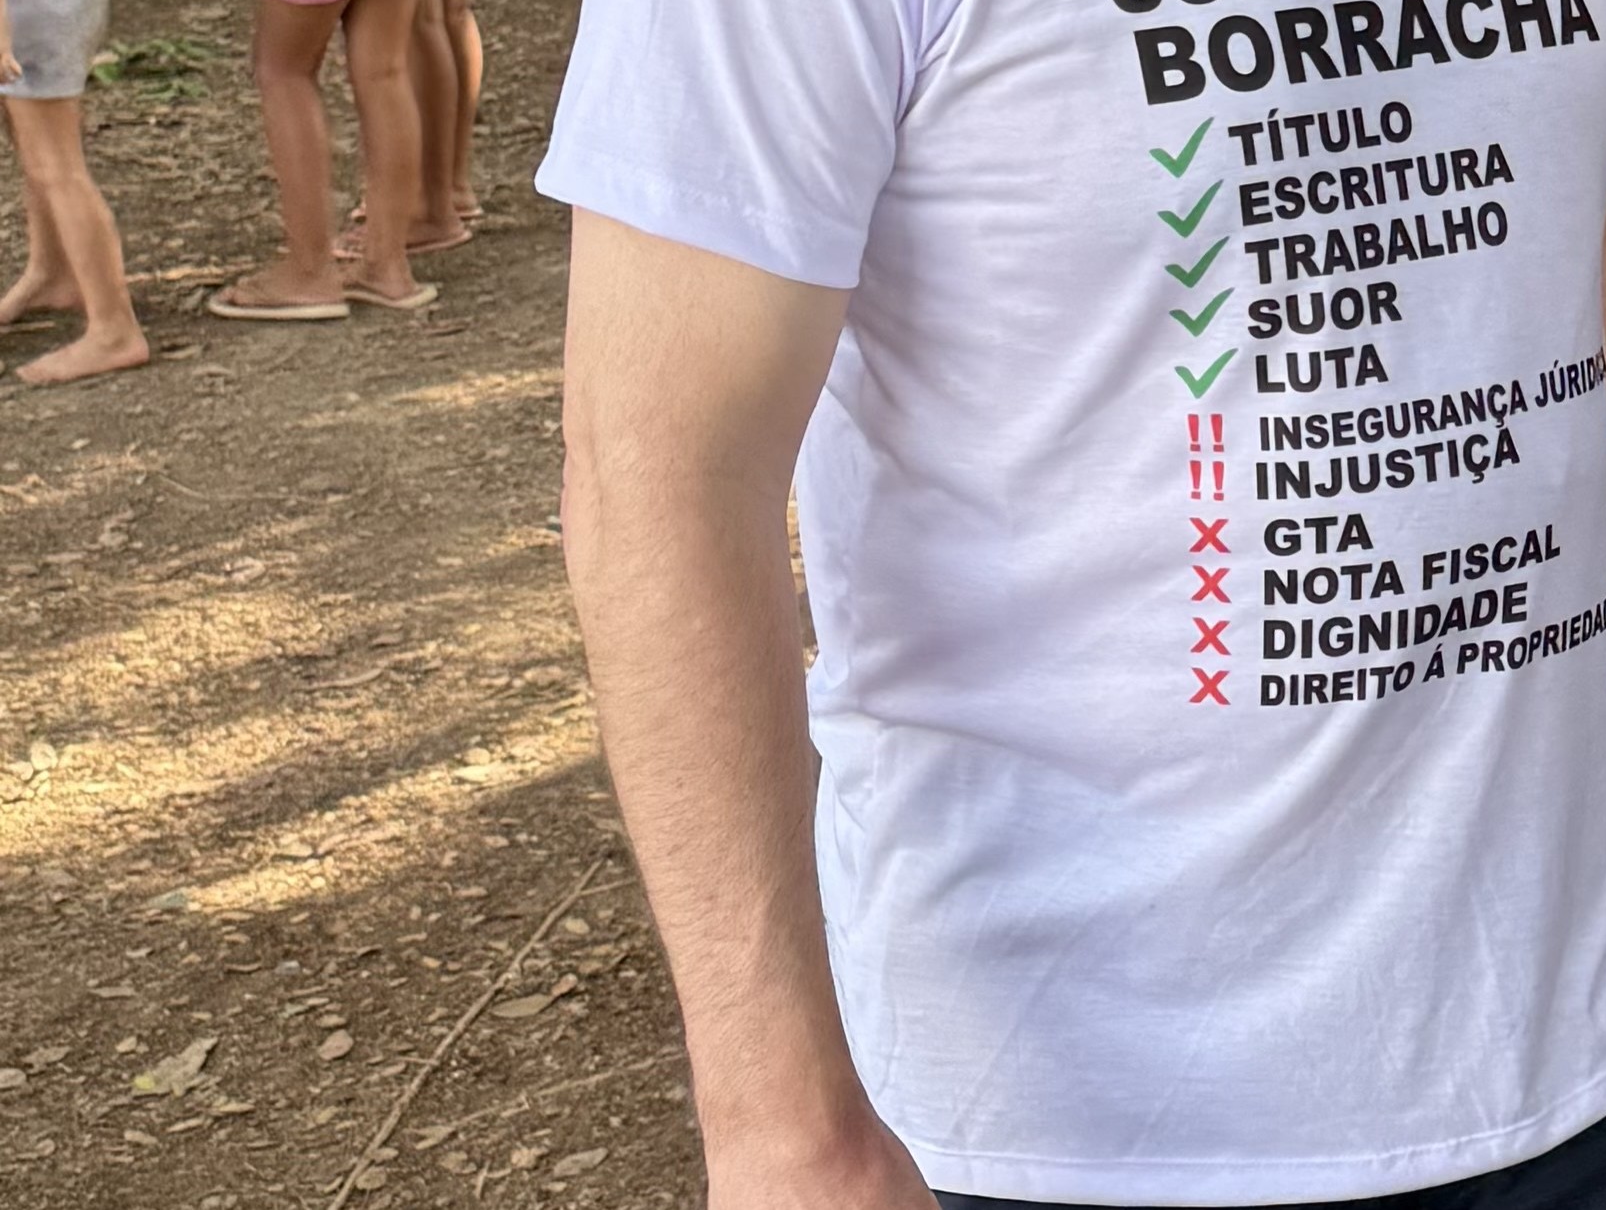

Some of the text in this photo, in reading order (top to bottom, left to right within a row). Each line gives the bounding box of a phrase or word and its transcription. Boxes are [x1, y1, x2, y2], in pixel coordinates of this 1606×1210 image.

[1227, 101, 1413, 167] TÍTULO
[1238, 143, 1515, 227] ESCRITURA
[1244, 201, 1508, 285] TRABALHO
[1247, 281, 1403, 340] SUOR
[1255, 343, 1389, 393] LUTA
[1260, 379, 1529, 451] INSEGURANÇA
[1255, 427, 1521, 500] INJUSTIÇA
[1263, 513, 1374, 557] GTA
[1264, 560, 1405, 606] NOTA
[1422, 523, 1561, 591] FISCAL
[1263, 581, 1528, 660] DIGNIDADE
[1260, 660, 1416, 706] DIREITO
[1421, 643, 1446, 683] Á
